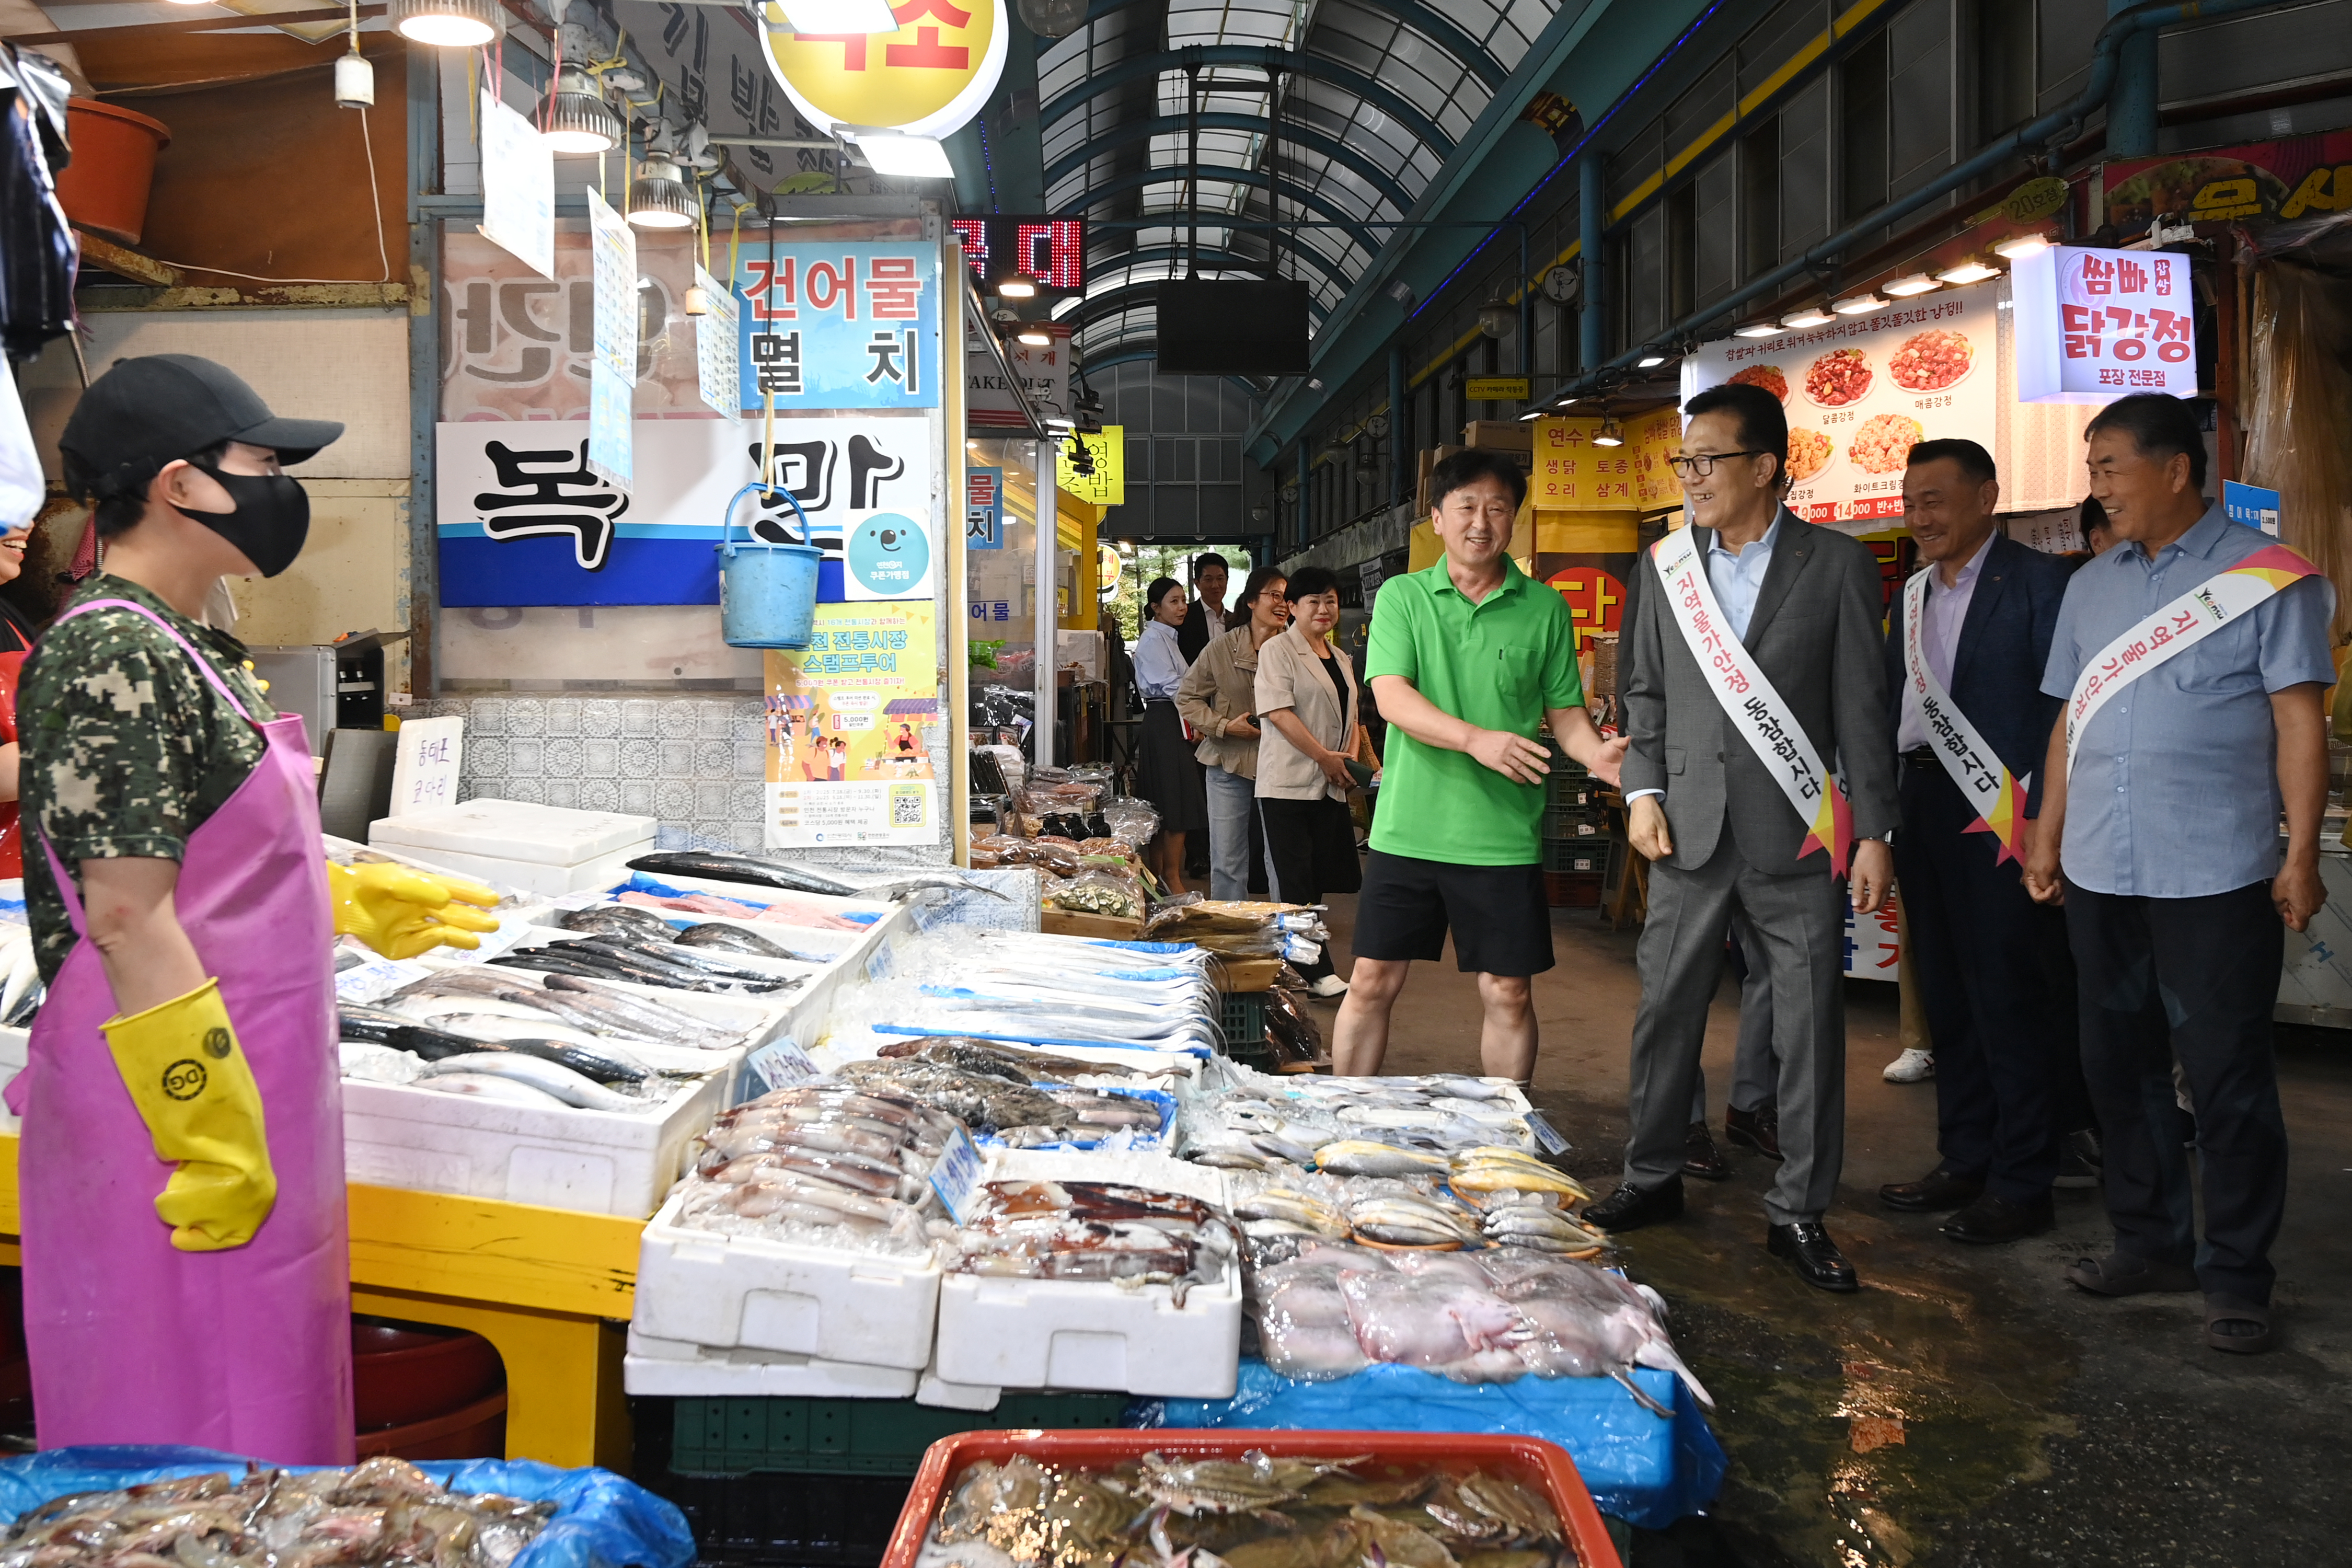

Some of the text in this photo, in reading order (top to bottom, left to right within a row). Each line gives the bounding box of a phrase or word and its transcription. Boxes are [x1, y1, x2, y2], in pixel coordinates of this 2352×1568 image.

[2082, 254, 2148, 295] 쌈빠
[2156, 261, 2170, 294] 찹쌀
[741, 256, 923, 320] 건어물
[1725, 347, 1756, 362] 찹쌀과
[1757, 339, 1785, 355] 귀리로
[1787, 332, 1805, 349] 튀겨
[1929, 301, 1963, 320] 강정!!
[2061, 303, 2191, 363] 닭강정
[751, 330, 919, 395] 멸치
[968, 375, 1007, 390] AKE
[2099, 368, 2165, 387] 포장 전문점
[1915, 395, 1952, 410] 매콤강정
[1823, 411, 1854, 425] 달콤강정
[1548, 428, 1584, 448] 연수
[1546, 459, 1629, 475] 생닭 토종
[1545, 482, 1628, 498] 오리 삼계
[968, 511, 994, 543] 치
[870, 570, 909, 580] 쿠폰가맹점
[1663, 551, 1691, 575] Yeonsu
[971, 602, 1010, 621] 어물
[2198, 586, 2224, 620] Yeonsu
[832, 630, 908, 651] 전통시장
[803, 652, 896, 674] 스탬프투어
[2075, 609, 2199, 720] 지역물가안정
[1677, 571, 1822, 800] 지역물가안정 동참합시다
[1923, 696, 2000, 793] 동참합시다
